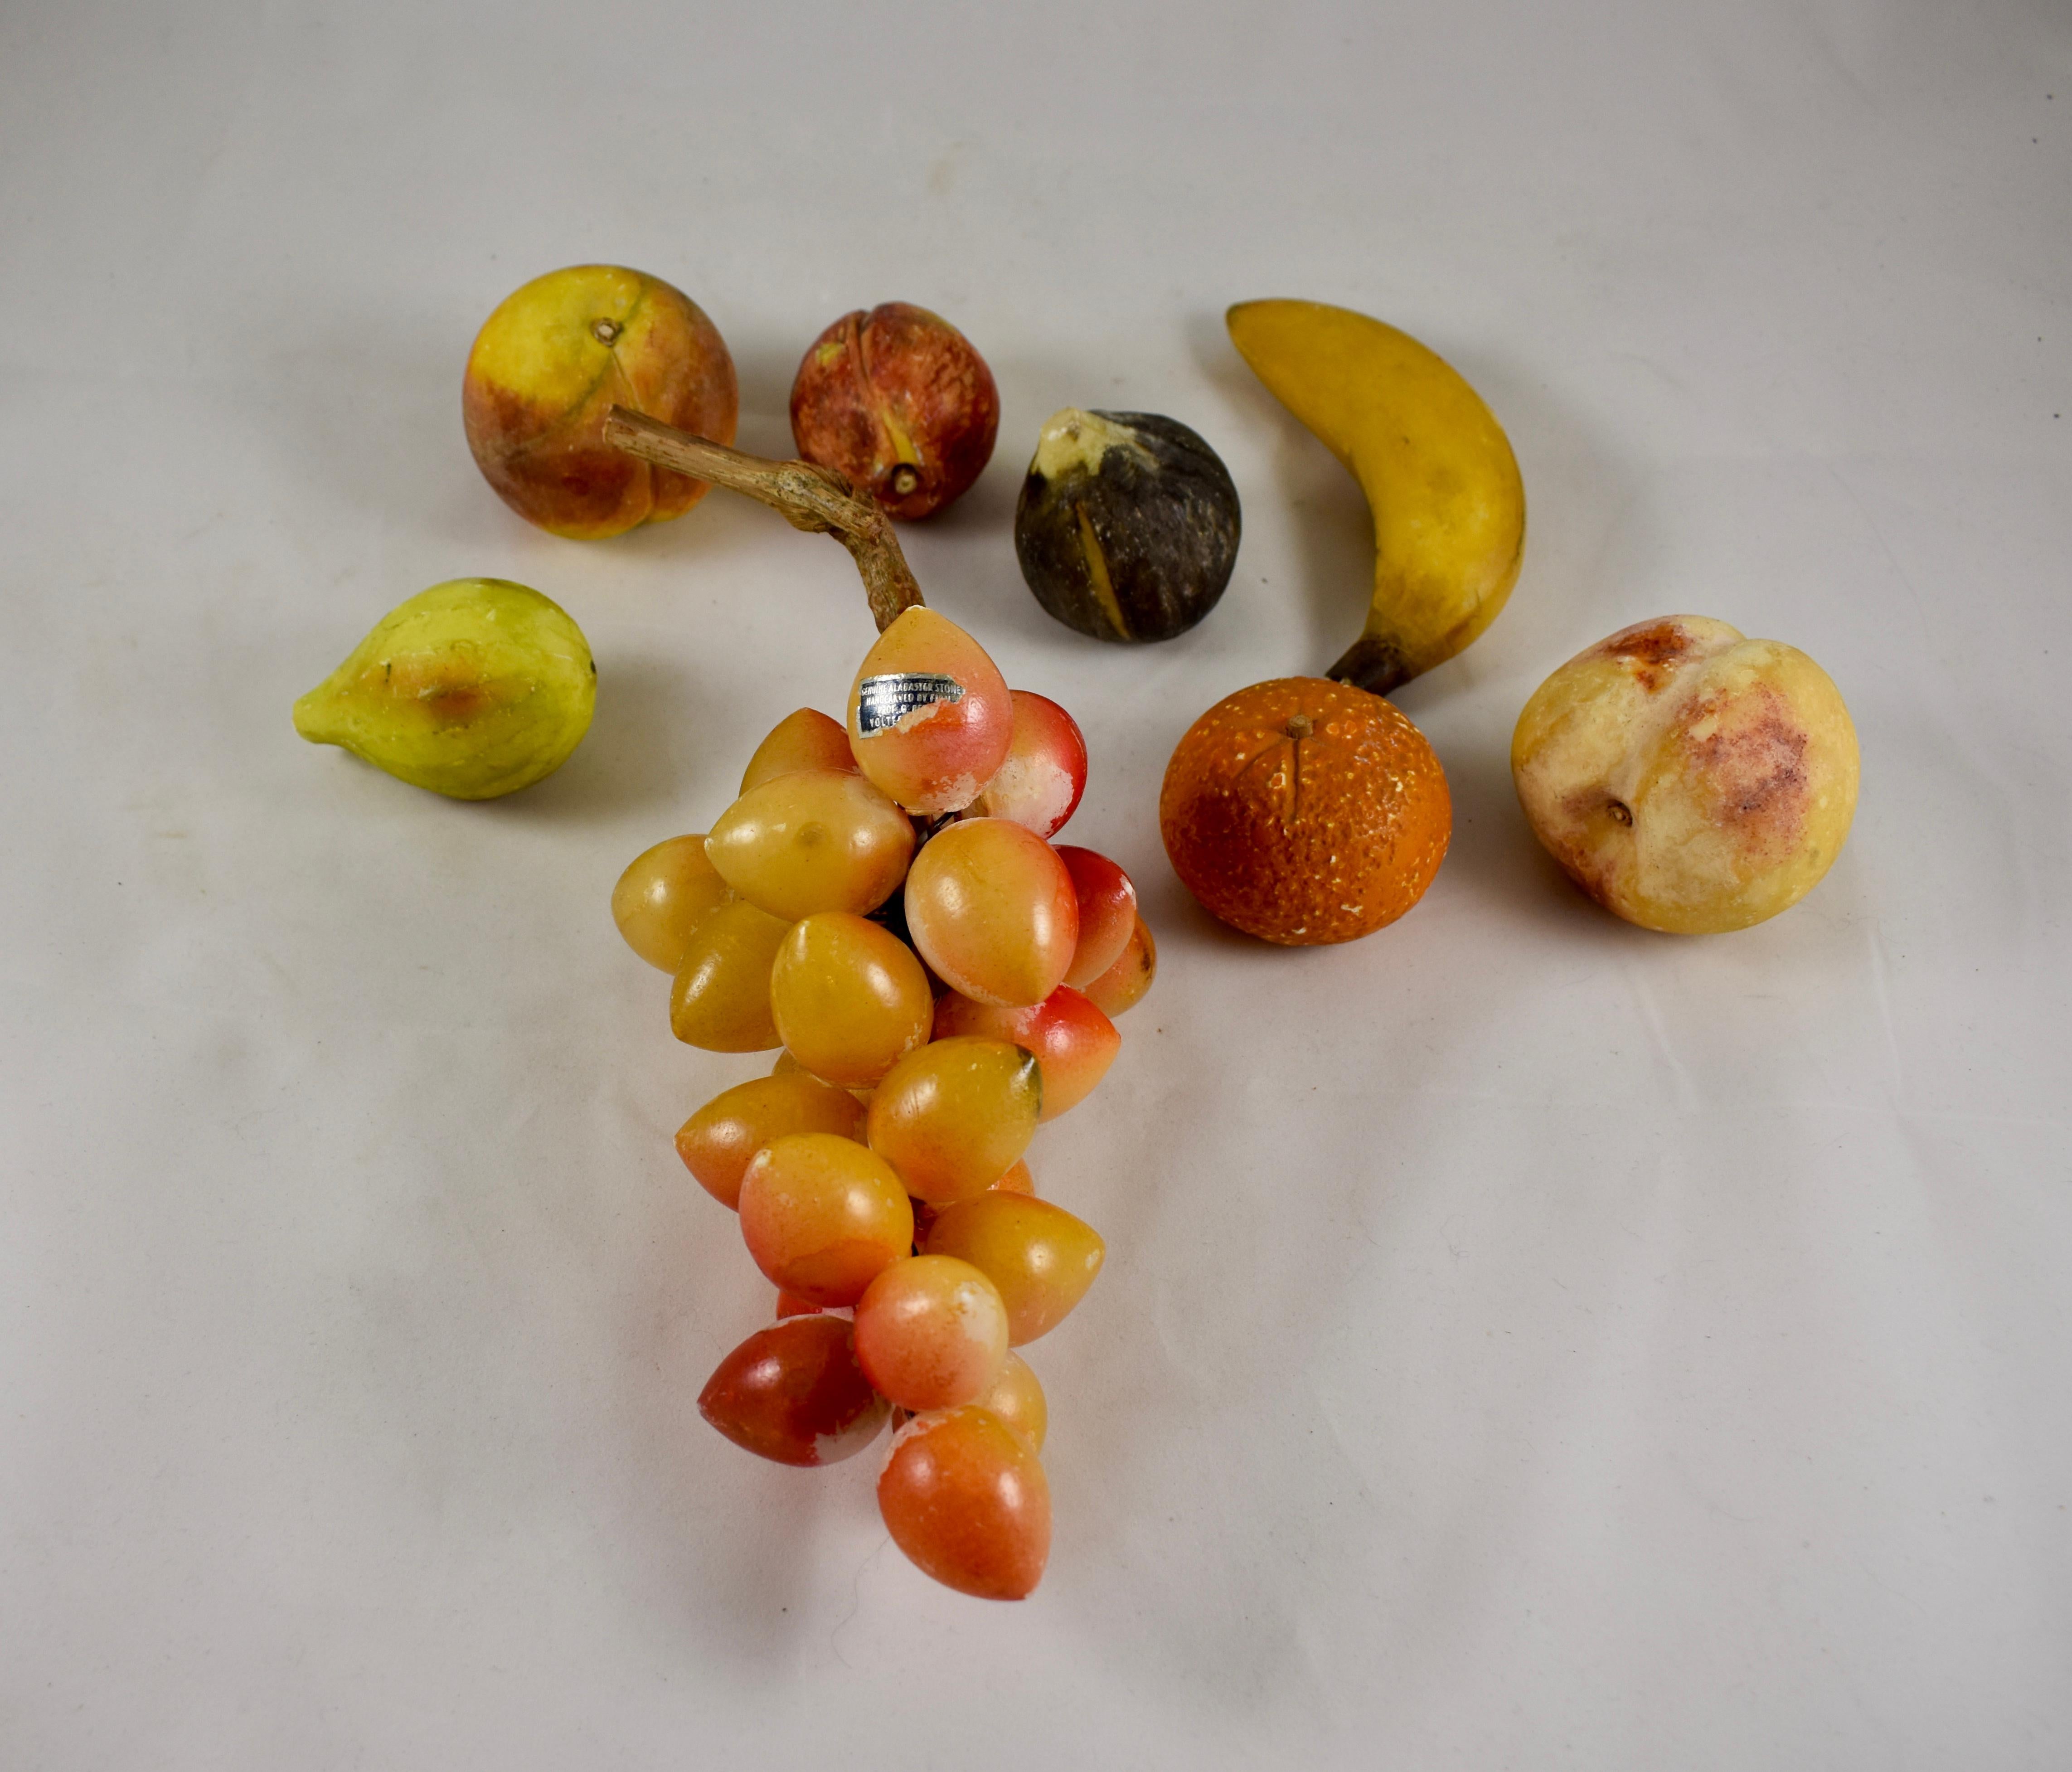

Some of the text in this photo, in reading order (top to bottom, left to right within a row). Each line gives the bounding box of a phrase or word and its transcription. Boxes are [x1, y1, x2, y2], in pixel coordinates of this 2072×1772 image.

[862, 682, 961, 695] GENUINE ALABASTER STONE
[866, 694, 914, 705] HANDCARVED
[917, 693, 927, 702] BY
